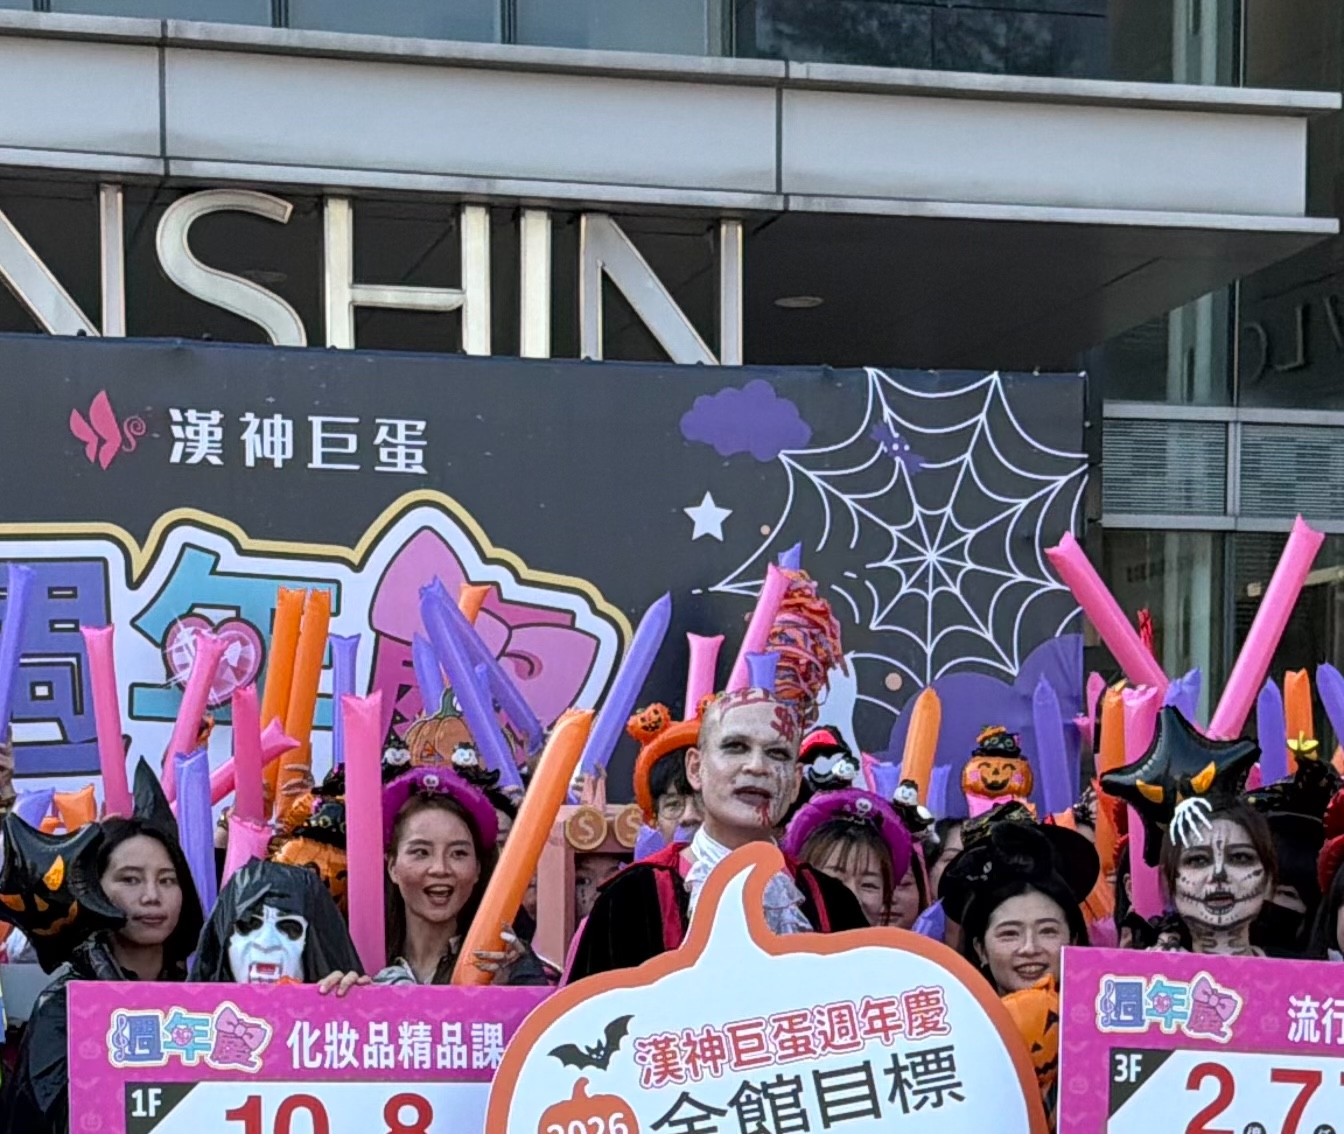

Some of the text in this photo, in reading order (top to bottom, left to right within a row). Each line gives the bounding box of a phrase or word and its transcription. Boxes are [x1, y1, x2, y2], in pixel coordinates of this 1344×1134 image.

[168, 407, 428, 475] 漢神巨蛋
[286, 1021, 505, 1070] 化妝品精品課
[634, 984, 950, 1088] 漢神巨蛋週年慶
[1114, 1054, 1143, 1082] 3F
[131, 1088, 162, 1117] 1F
